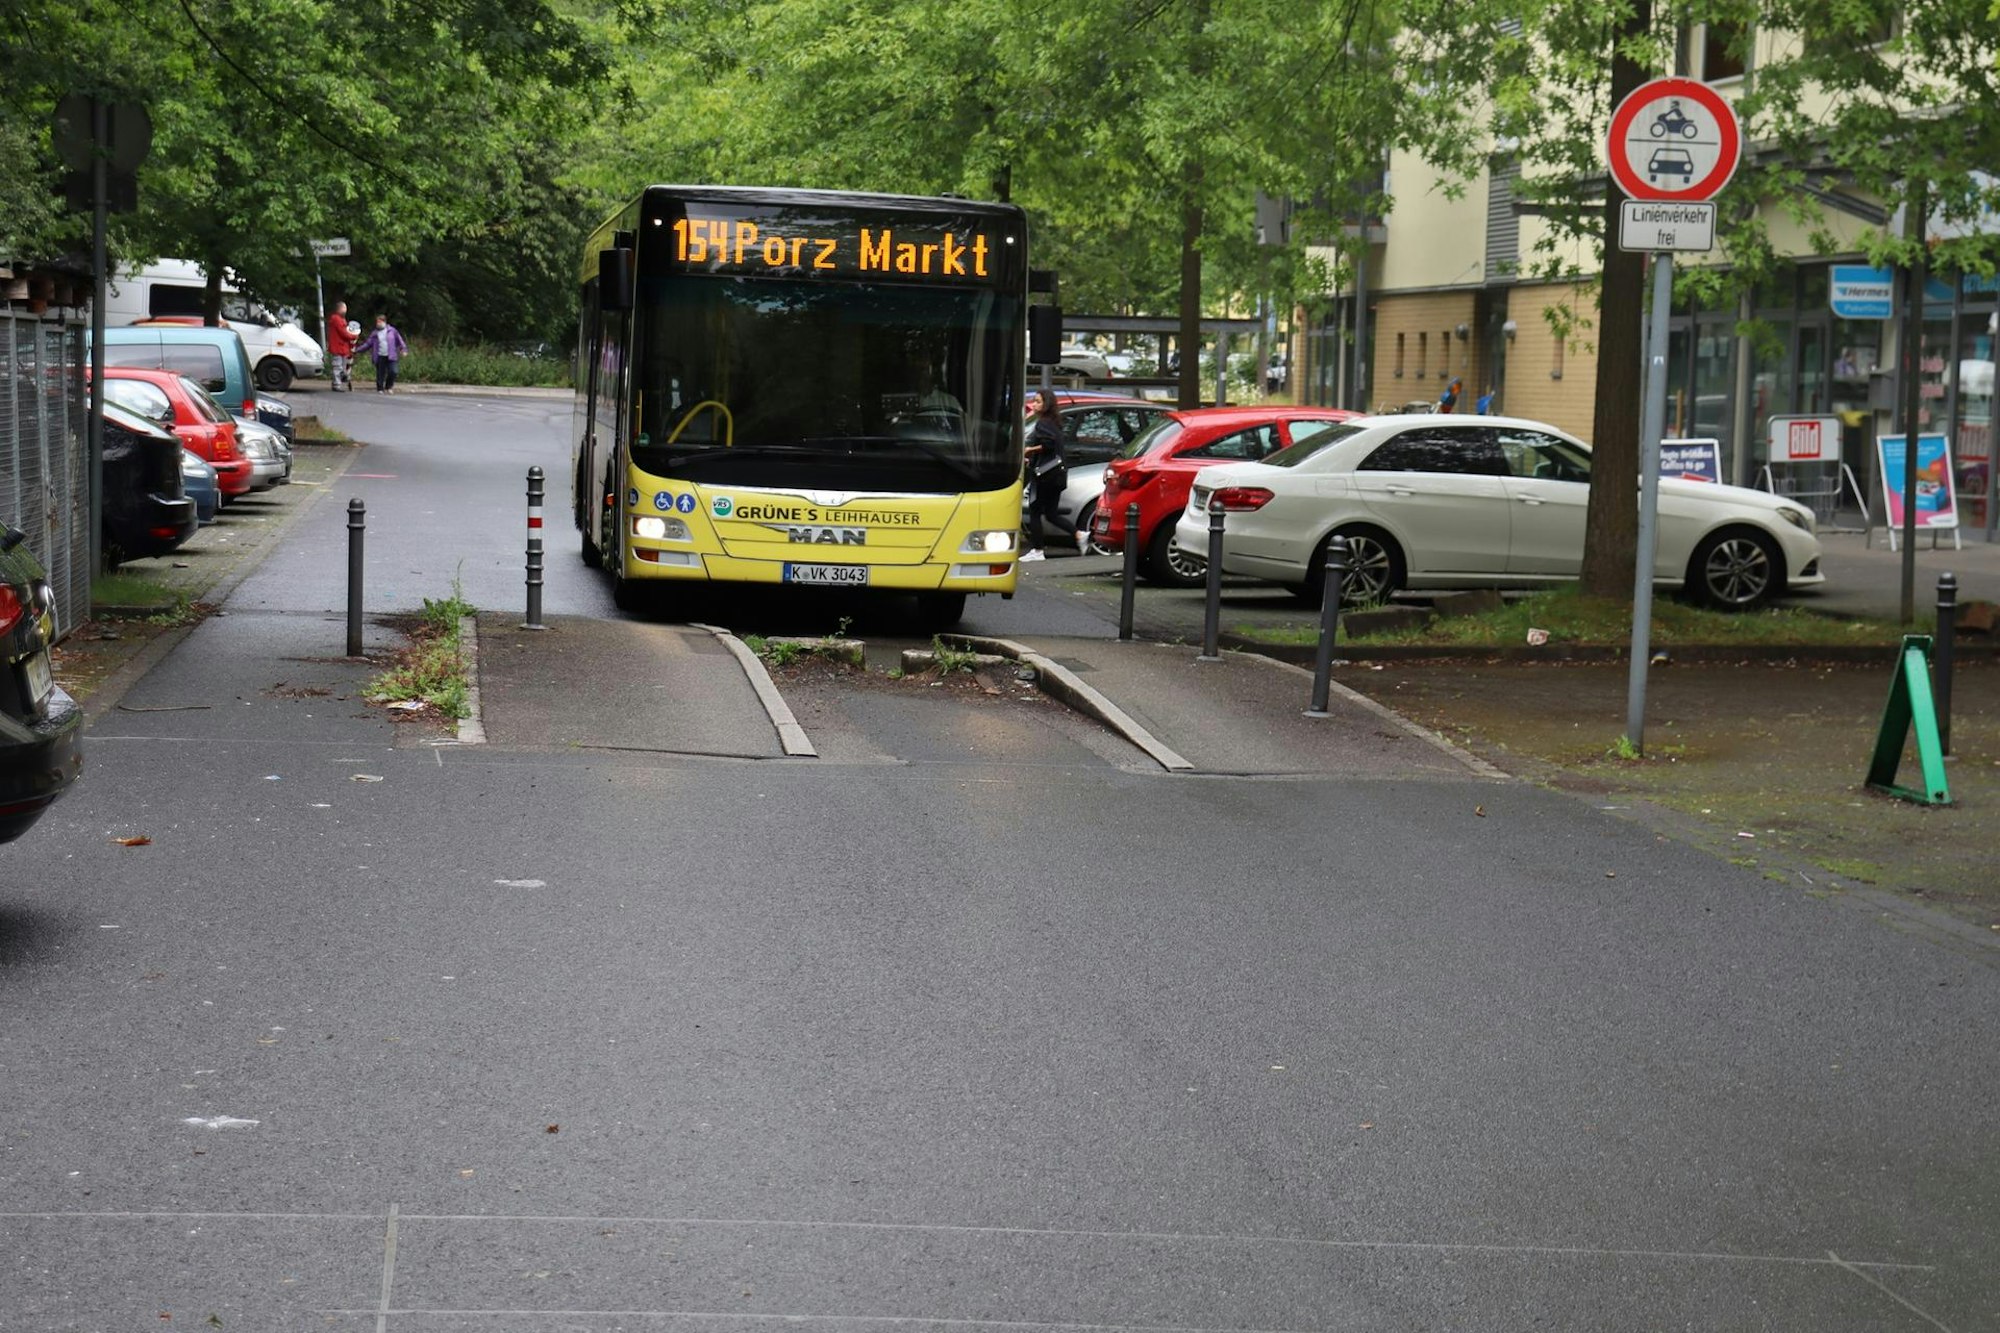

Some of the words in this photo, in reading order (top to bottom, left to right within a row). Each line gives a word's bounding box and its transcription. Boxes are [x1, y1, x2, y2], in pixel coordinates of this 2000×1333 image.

[1631, 206, 1708, 224] Linienverkehr
[1657, 228, 1676, 246] frei
[673, 218, 728, 263] 154
[734, 221, 837, 270] Porz
[860, 228, 988, 277] Markt
[1848, 286, 1889, 297] Hermes
[788, 527, 866, 546] MAN
[792, 566, 801, 580] K
[810, 566, 828, 580] VK
[831, 567, 865, 582] 3043
